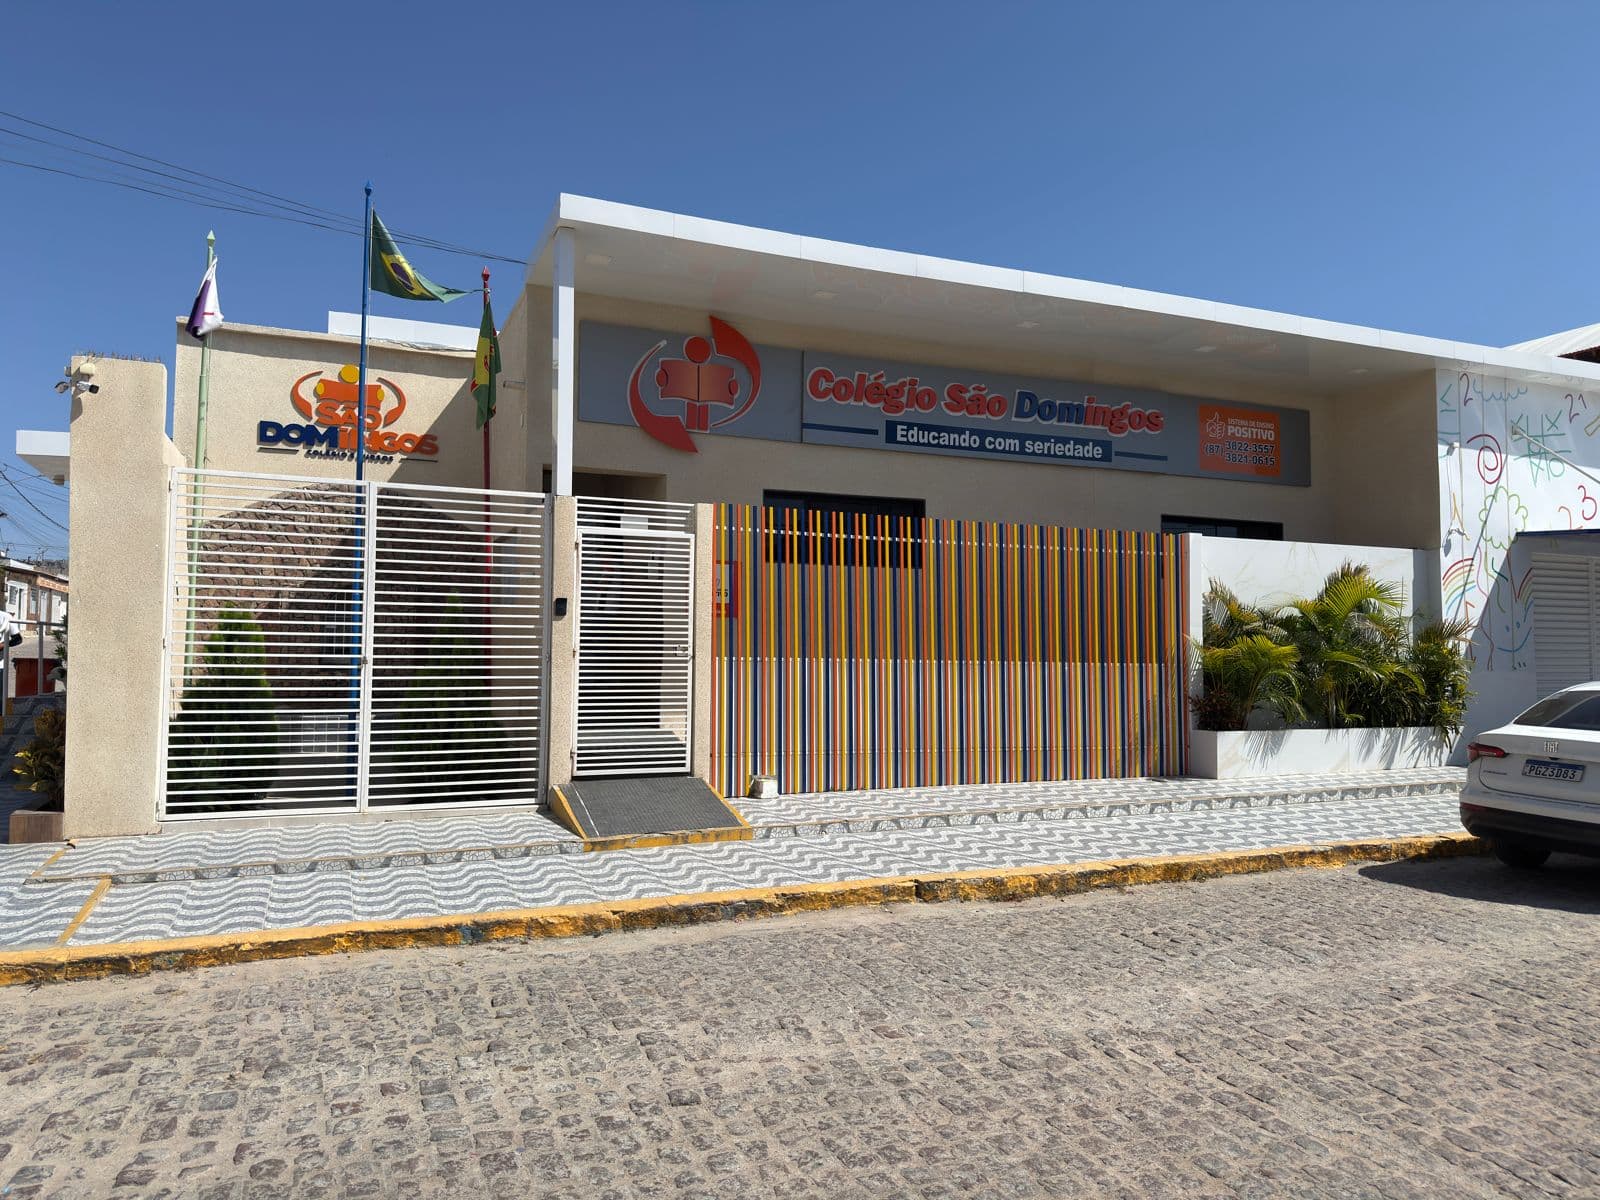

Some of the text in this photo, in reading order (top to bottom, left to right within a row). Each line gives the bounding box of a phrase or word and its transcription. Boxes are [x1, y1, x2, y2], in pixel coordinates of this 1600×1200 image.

[806, 367, 1165, 436] Colégio São Domingos
[1227, 426, 1275, 440] POSITIVO
[896, 424, 1103, 459] Educando com seriedade
[1205, 441, 1275, 456] (87) 3822-3557
[361, 453, 394, 462] URSOS
[1226, 453, 1275, 466] 3821-0615
[1528, 766, 1577, 780] PGZ3D83
